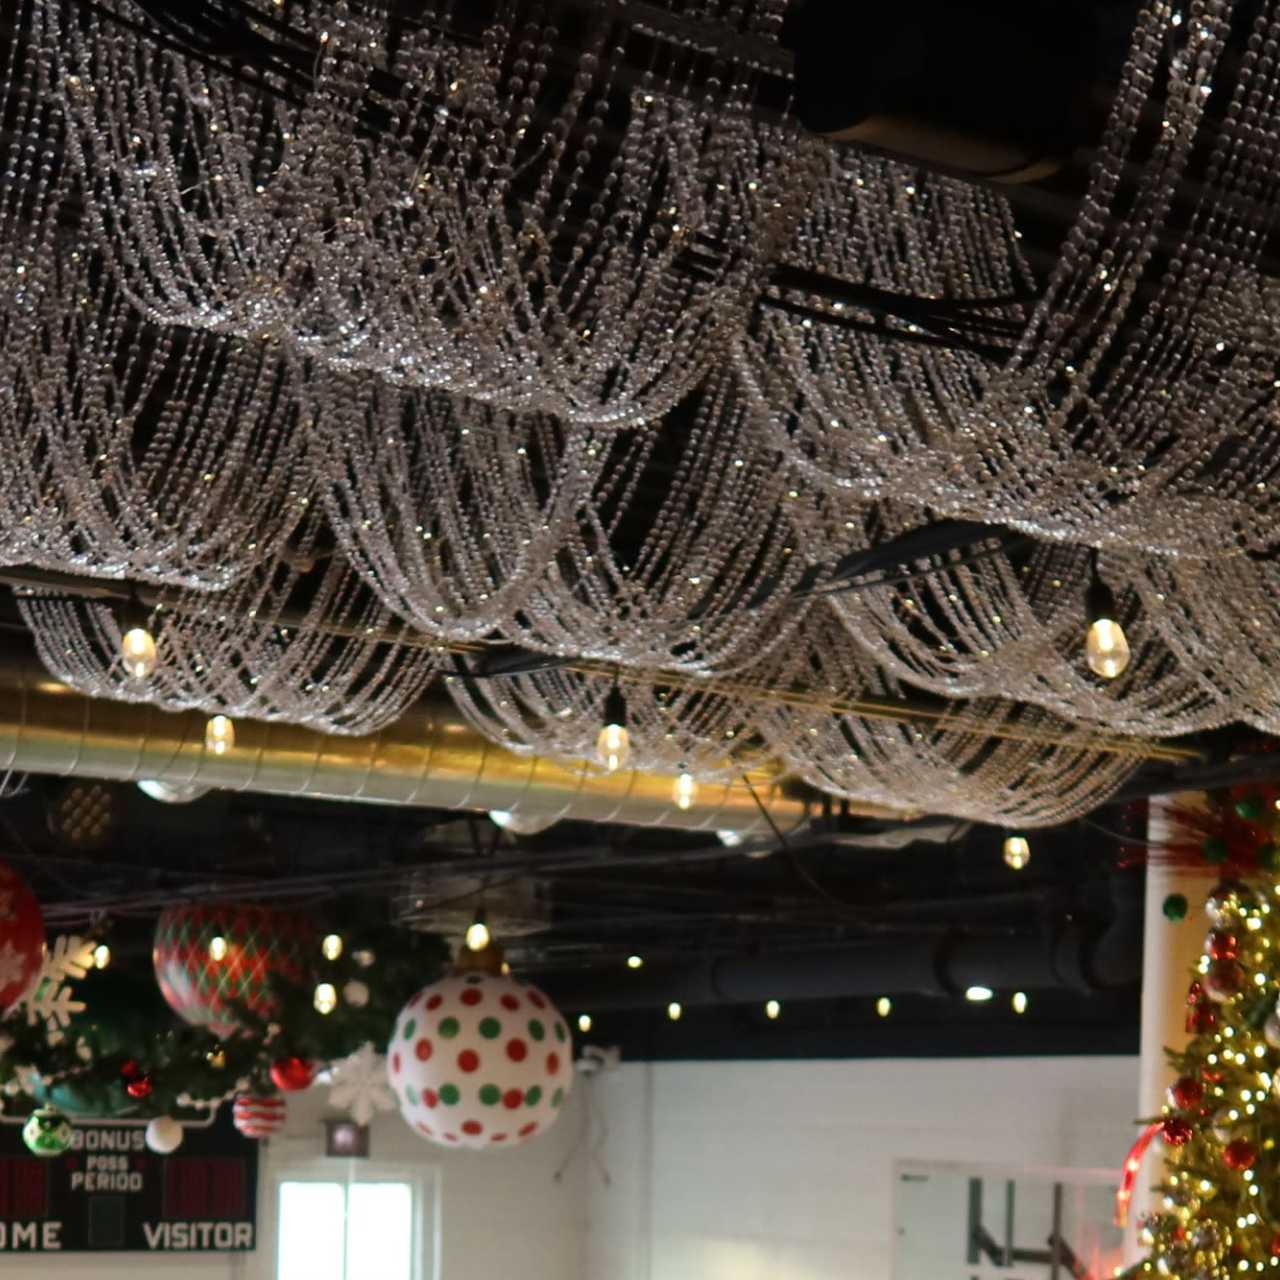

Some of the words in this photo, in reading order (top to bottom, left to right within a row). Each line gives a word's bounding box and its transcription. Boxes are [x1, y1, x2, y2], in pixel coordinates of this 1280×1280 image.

[71, 1129, 145, 1151] BONUS
[71, 1172, 143, 1191] PERIOD
[142, 1221, 254, 1250] VISITOR
